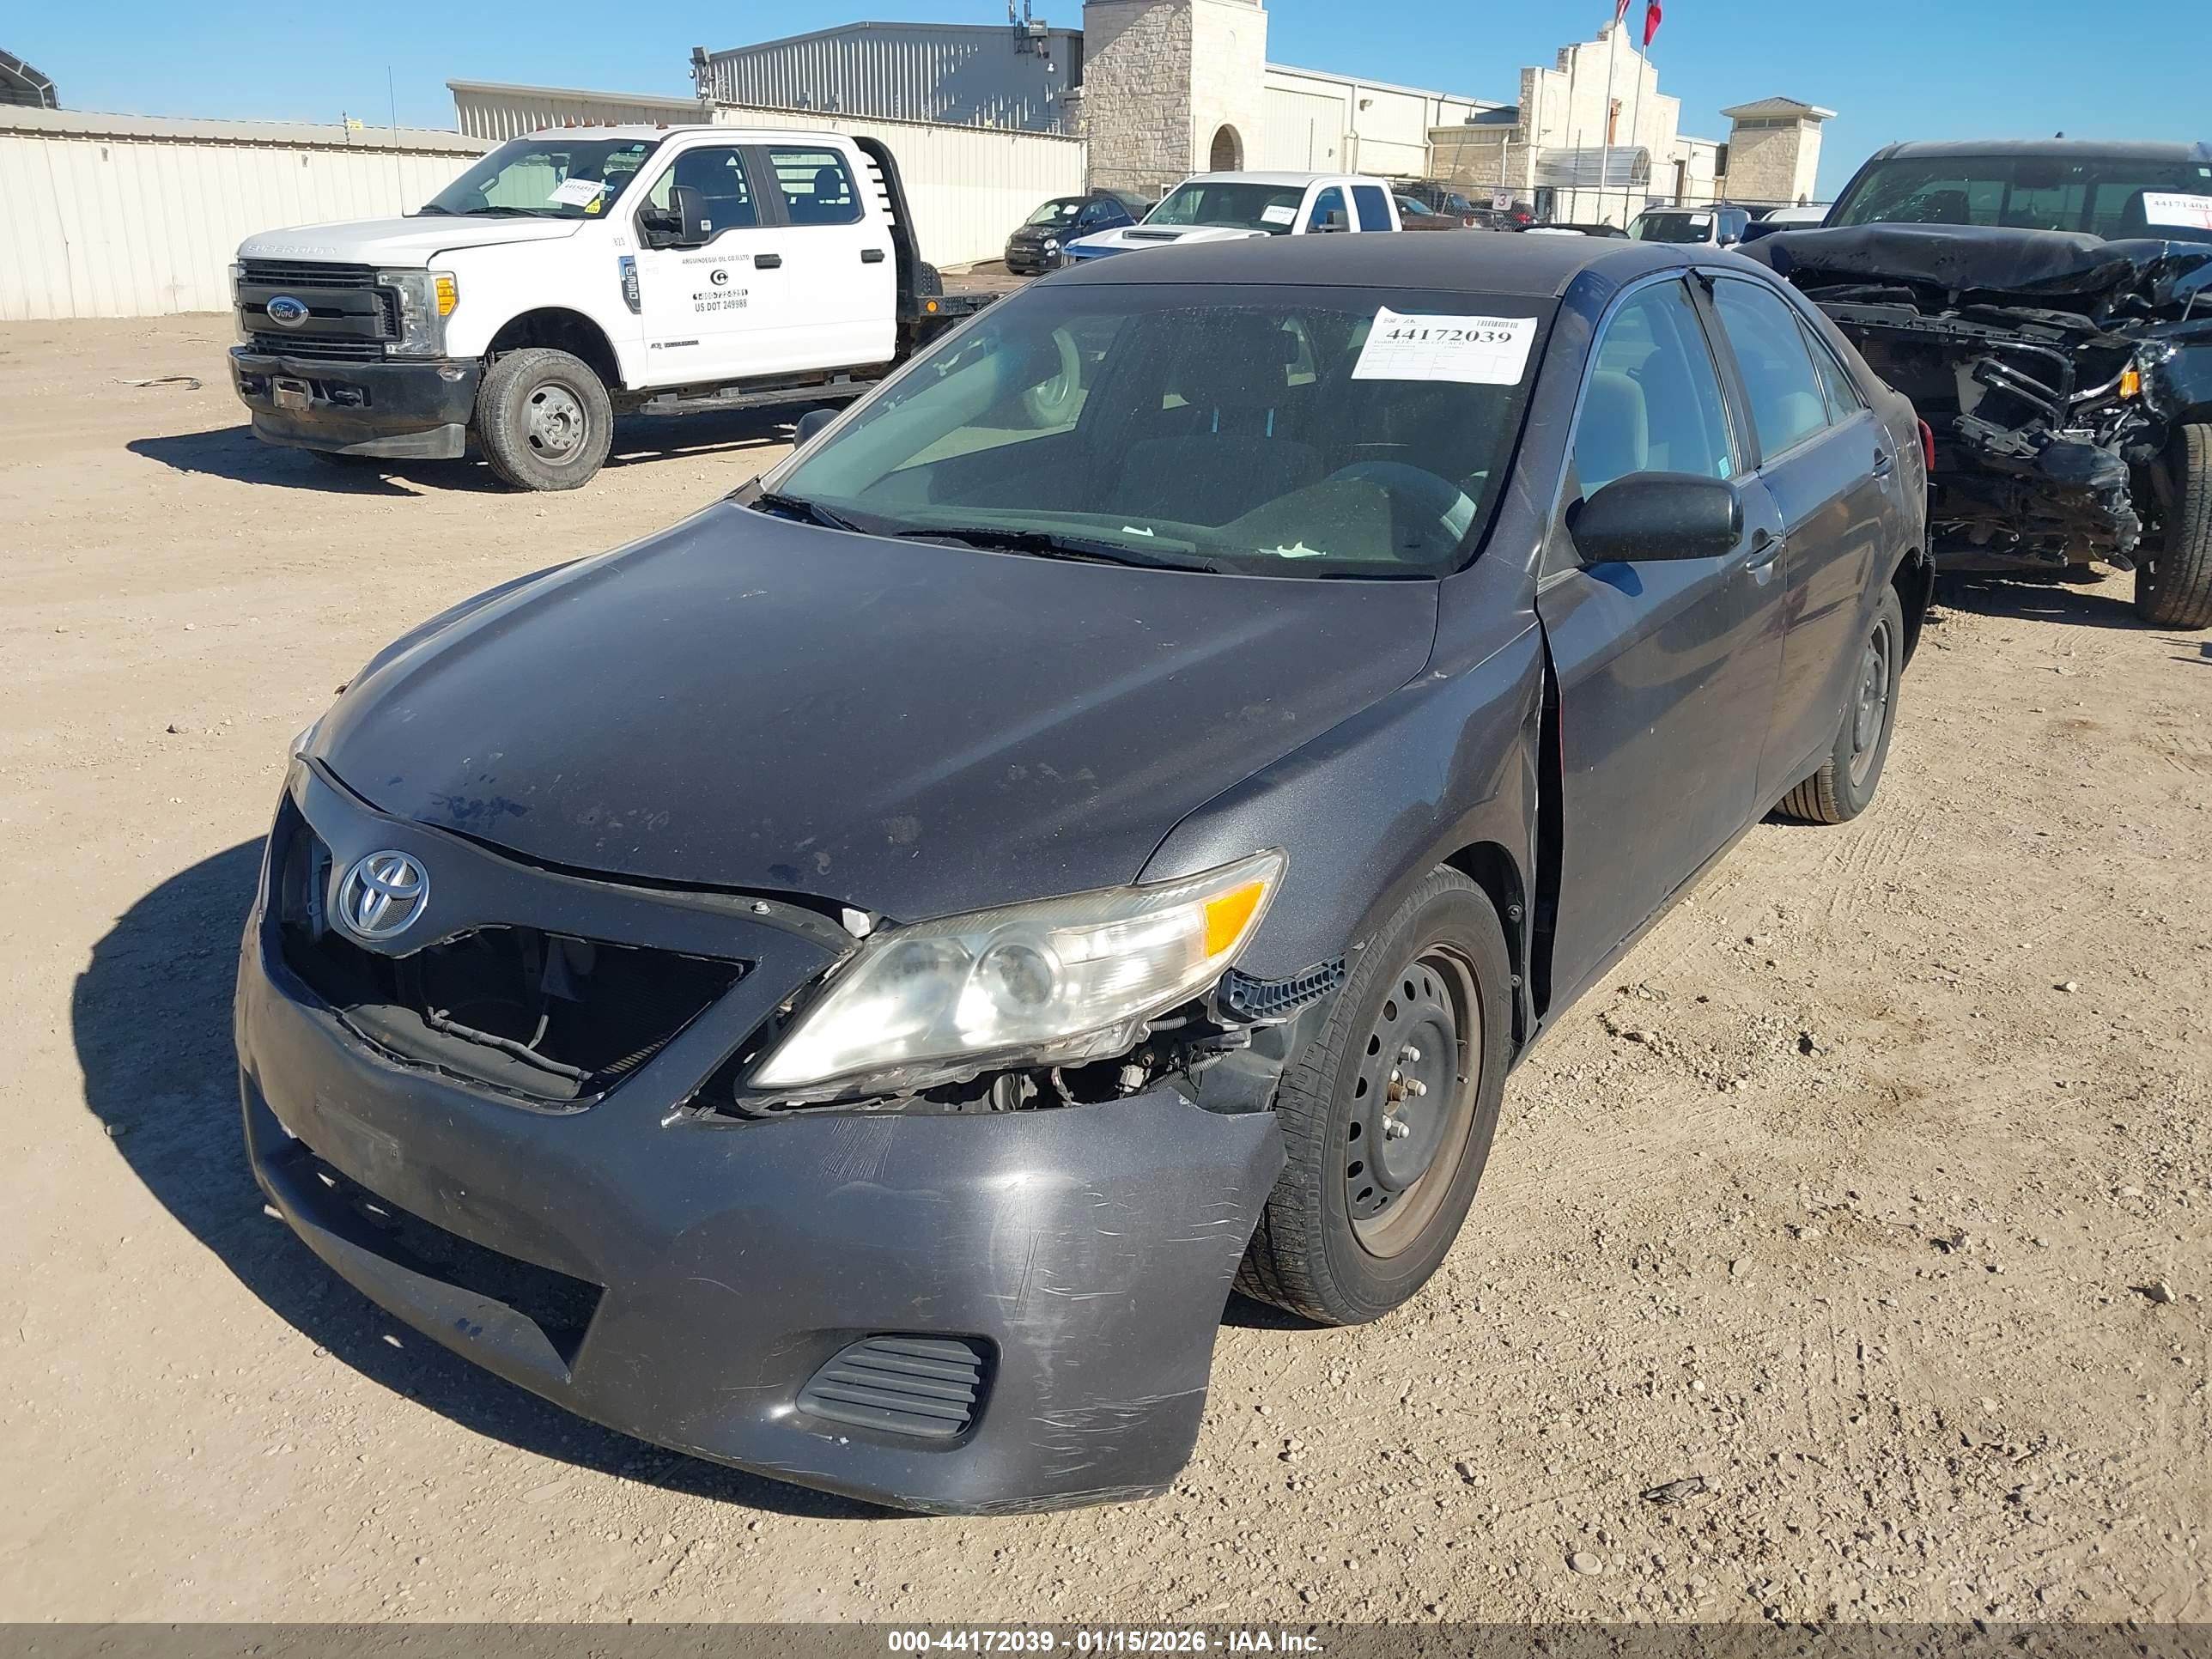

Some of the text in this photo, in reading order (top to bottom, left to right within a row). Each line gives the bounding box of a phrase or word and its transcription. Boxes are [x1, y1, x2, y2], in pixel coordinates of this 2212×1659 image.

[1498, 193, 1507, 207] 3
[246, 244, 338, 256] SUPER DUTY
[275, 303, 295, 319] Ford
[695, 302, 705, 313] US
[707, 301, 721, 312] DOT
[1386, 328, 1512, 343] 44172039
